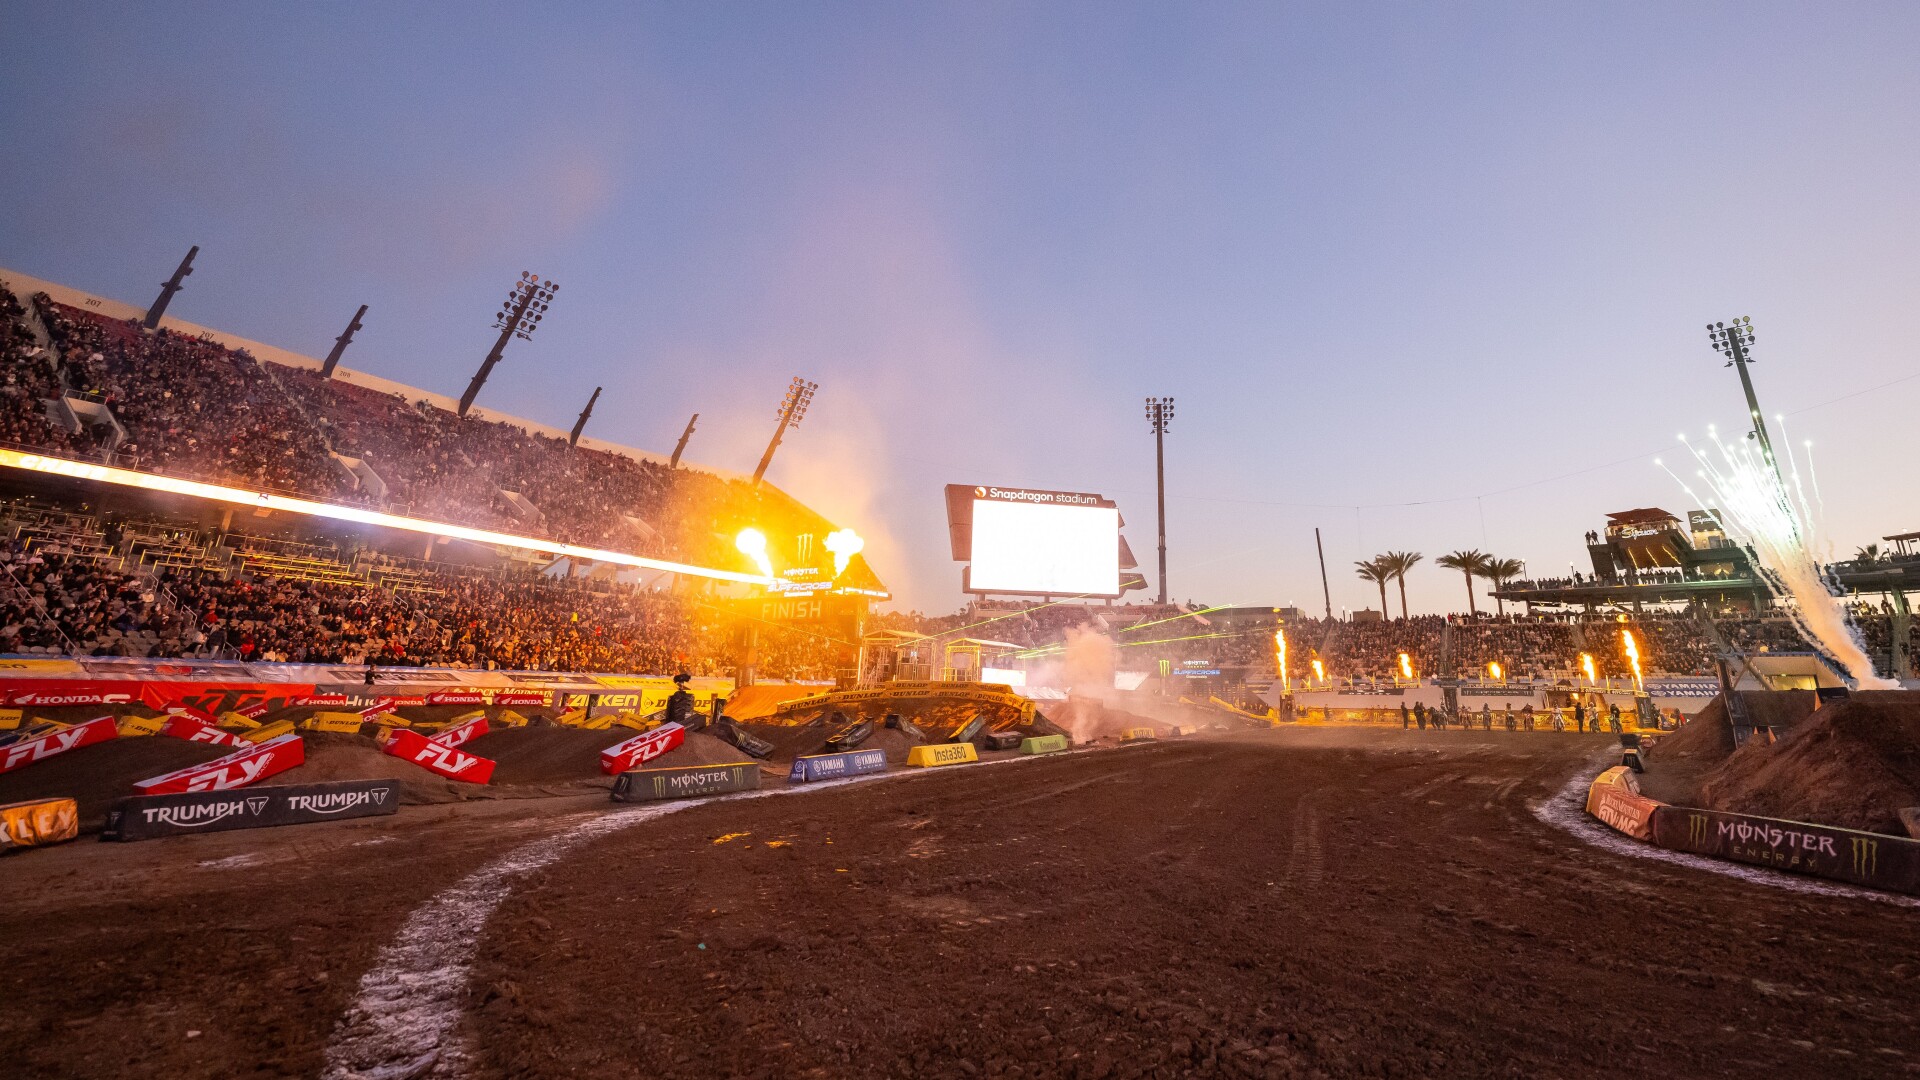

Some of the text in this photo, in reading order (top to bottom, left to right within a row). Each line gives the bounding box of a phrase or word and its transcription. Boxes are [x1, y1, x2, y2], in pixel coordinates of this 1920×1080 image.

[84, 298, 102, 308] 207
[989, 487, 1097, 504] Snapdragon stadium
[760, 600, 822, 619] FINISH
[35, 694, 102, 704] HONDA
[655, 699, 711, 708] DOP
[789, 697, 831, 710] DUNLOP
[842, 691, 884, 700] DUNLOP
[4, 726, 87, 769] FLY
[628, 735, 673, 767] FLY
[933, 746, 967, 763] Insta360
[415, 742, 478, 773] FLY
[820, 758, 845, 772] YAMAHA
[860, 752, 883, 766] YAMAHA
[186, 752, 272, 792] FLY
[671, 771, 729, 789] MONSTER
[681, 785, 721, 796] ENERGY
[288, 791, 370, 814] TRIUMPH
[143, 800, 244, 826] TRIUMPH
[1717, 821, 1838, 857] MONSTER
[1733, 845, 1817, 867] ENERGY
